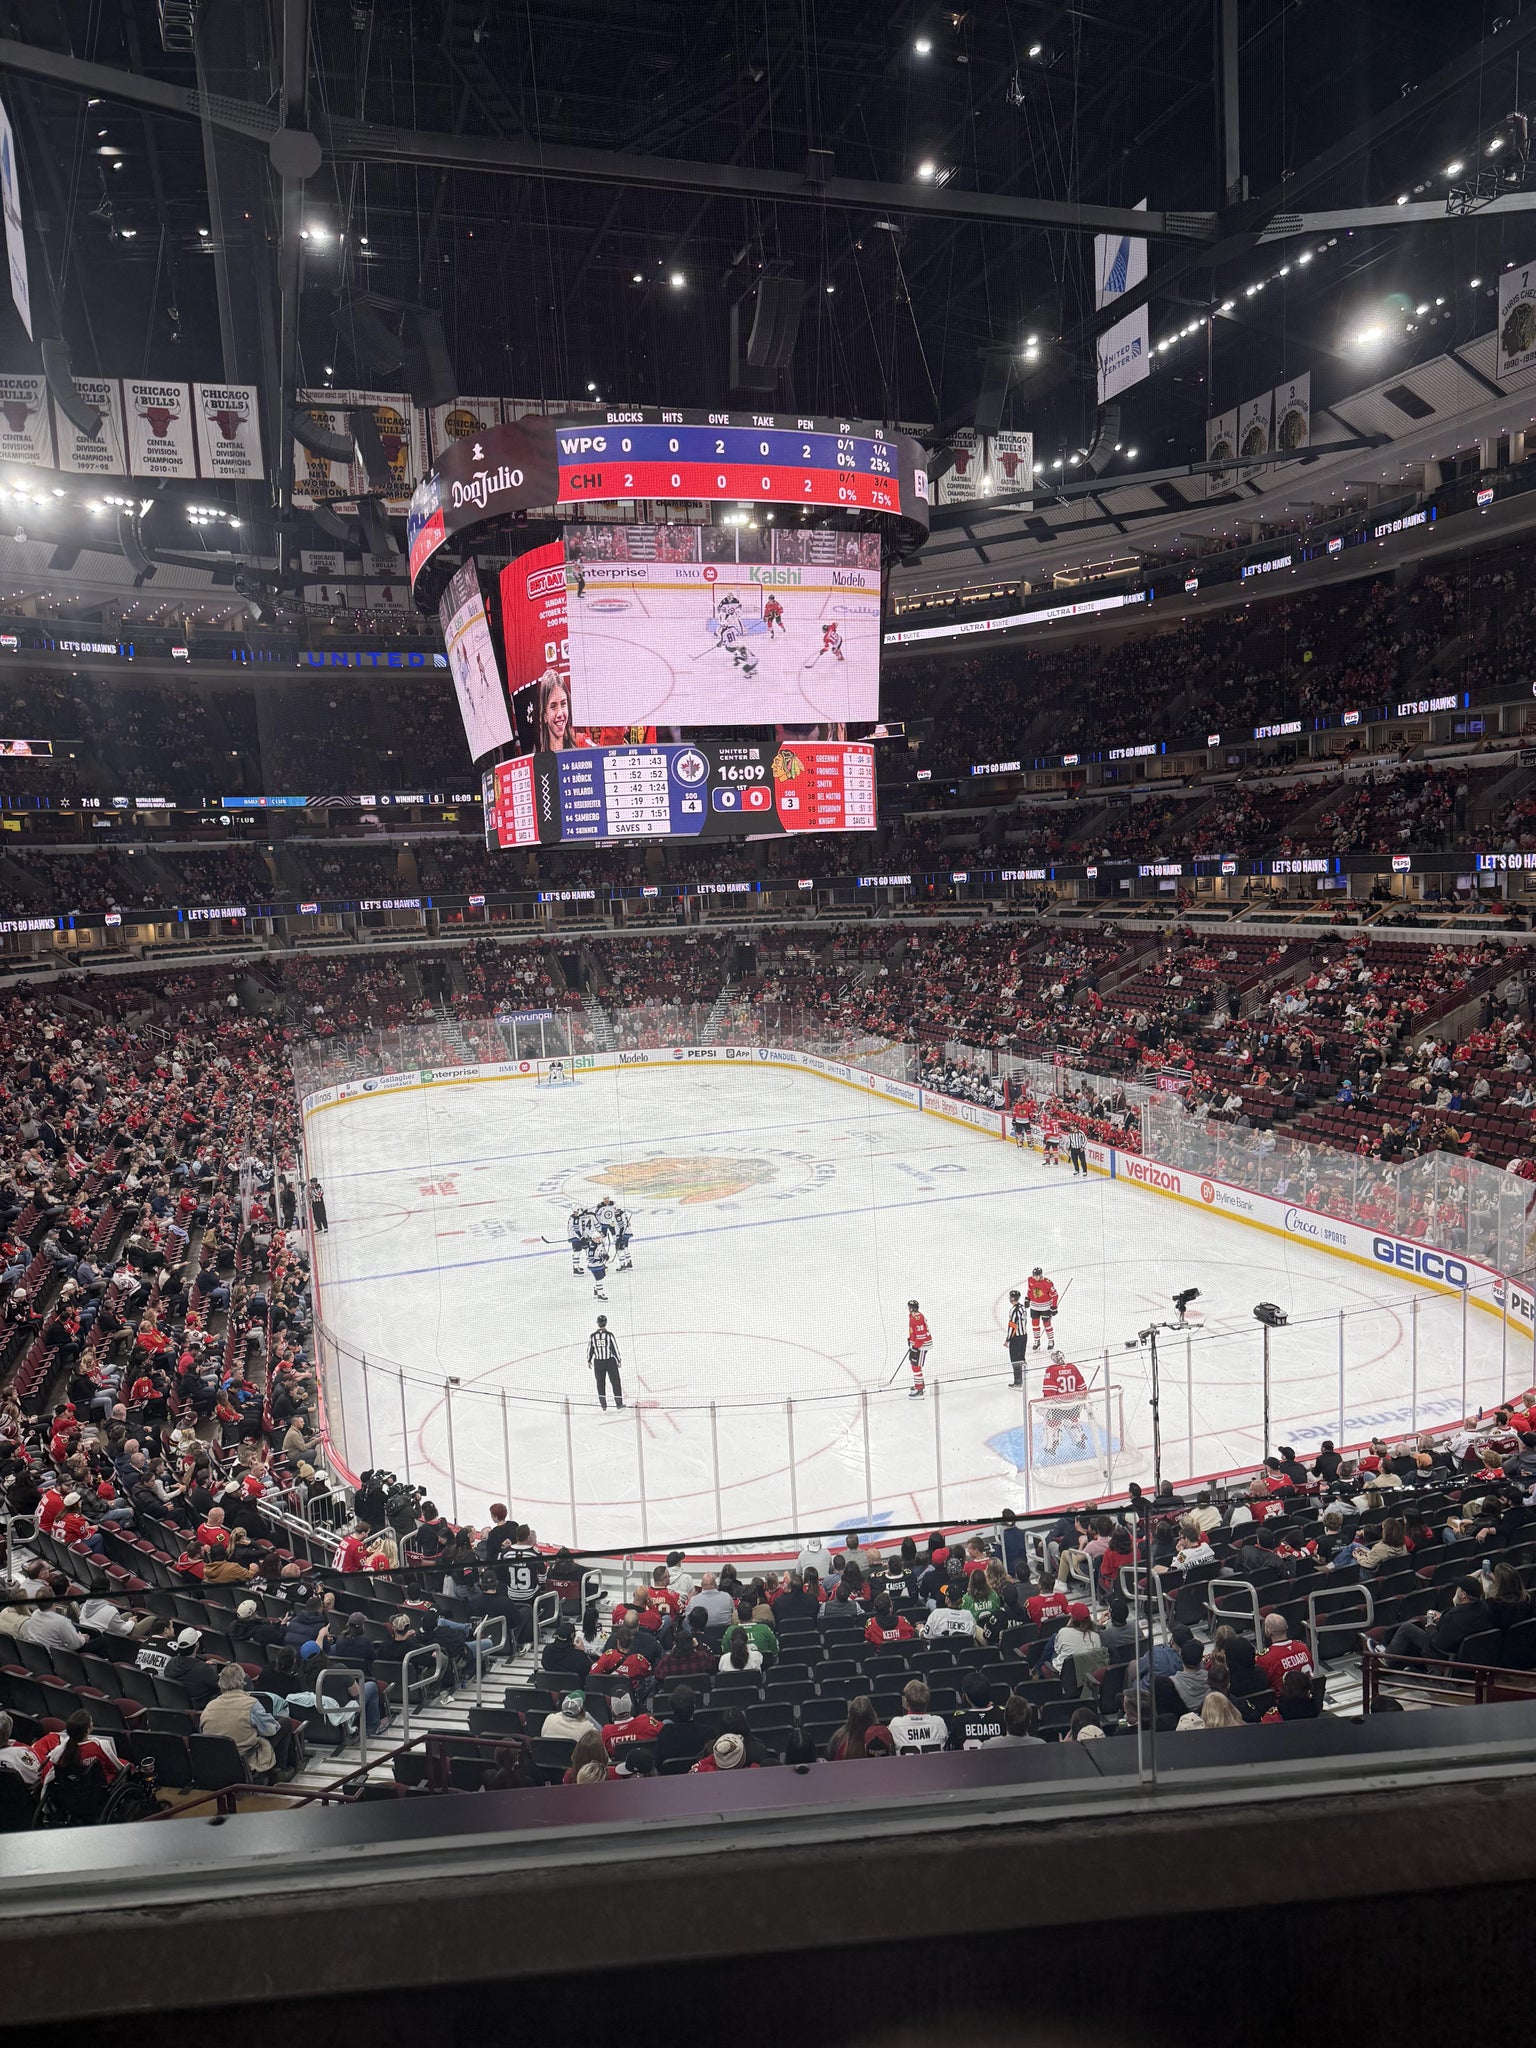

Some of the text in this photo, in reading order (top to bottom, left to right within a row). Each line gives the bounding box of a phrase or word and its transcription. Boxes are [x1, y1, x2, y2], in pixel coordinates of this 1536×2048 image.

[131, 385, 181, 398] CHICAGO
[202, 389, 250, 401] CHICAGO
[141, 397, 175, 407] BULLS
[211, 400, 245, 411] BULLS
[607, 413, 644, 424] BLOCKS
[662, 412, 684, 424] HITS
[708, 413, 729, 425] GIVE
[752, 416, 775, 427] TAKE
[797, 420, 814, 431] PEN
[840, 424, 851, 433] PP
[147, 439, 176, 448] CENTRAL
[216, 442, 245, 450] CENTRAL
[561, 437, 888, 458] WPG 0 0 2 0 2 0/1 1/4
[995, 436, 1027, 446] CHICAGO
[76, 445, 108, 454] DIVISION
[147, 448, 178, 456] DIVISION
[215, 450, 246, 459] DIVISION
[999, 444, 1023, 453] BULLS
[72, 454, 114, 463] CHAMPIONS
[142, 457, 183, 466] CHAMPIONS
[211, 458, 251, 467] CHAMPIONS
[837, 452, 891, 474] 0% 25%
[570, 473, 889, 492] CHI 2 0 0 0 2 0/1 3/4
[292, 487, 348, 497] CHAMPIONS
[838, 487, 892, 507] 0% 75%
[1374, 511, 1425, 538] LET'S GO HAWKS
[580, 566, 866, 587] nterprise BMO Kalshi Modelo
[1046, 603, 1095, 619] ULTRA SUITE
[960, 619, 1009, 633] ULTRA SUITE
[730, 630, 741, 643] 81
[60, 640, 117, 655] LET'S GO HAWKS
[307, 651, 425, 668] UNITED
[1398, 695, 1457, 716] LET'S GO HAWKS
[611, 758, 617, 767] 2
[629, 758, 641, 766] :21
[649, 757, 662, 765] :43
[613, 771, 618, 780] 1
[629, 771, 642, 779] :52
[650, 770, 663, 779] :52
[718, 765, 765, 781] 16:09
[613, 785, 619, 793] 2
[630, 784, 643, 793] :42
[649, 783, 666, 792] 1:24
[614, 798, 619, 806] 1
[631, 797, 644, 805] :19
[652, 796, 664, 805] :19
[688, 798, 794, 811] 4 3
[721, 791, 764, 807] 0 0
[615, 811, 621, 820] 3
[632, 810, 644, 819] :37
[650, 809, 667, 818] 1:51
[615, 824, 641, 833] SAVES
[647, 823, 653, 831] 3
[360, 898, 420, 910] LET'S GO HAWKS
[514, 1012, 552, 1022] HYUNDAI
[619, 1053, 649, 1064] Modelo
[687, 1050, 717, 1058] PEPSI
[770, 1052, 797, 1062] FANDUEL
[379, 1072, 415, 1085] Gallagher
[425, 1067, 478, 1080] enterprise
[1088, 1149, 1105, 1162] TIRE
[1126, 1160, 1181, 1193] verizon
[1203, 1184, 1254, 1212] BY Byline Bank
[1284, 1207, 1347, 1245] Circa SPORTS
[1373, 1237, 1468, 1289] GEICO
[1056, 1375, 1077, 1394] 30
[508, 1566, 531, 1590] 19
[886, 1581, 907, 1591] KAISER
[947, 1620, 966, 1630] TOEWS
[882, 1629, 901, 1640] KEITH
[1281, 1652, 1309, 1670] BEDARD
[907, 1727, 931, 1741] SHAW
[965, 1723, 1001, 1737] BEDARD
